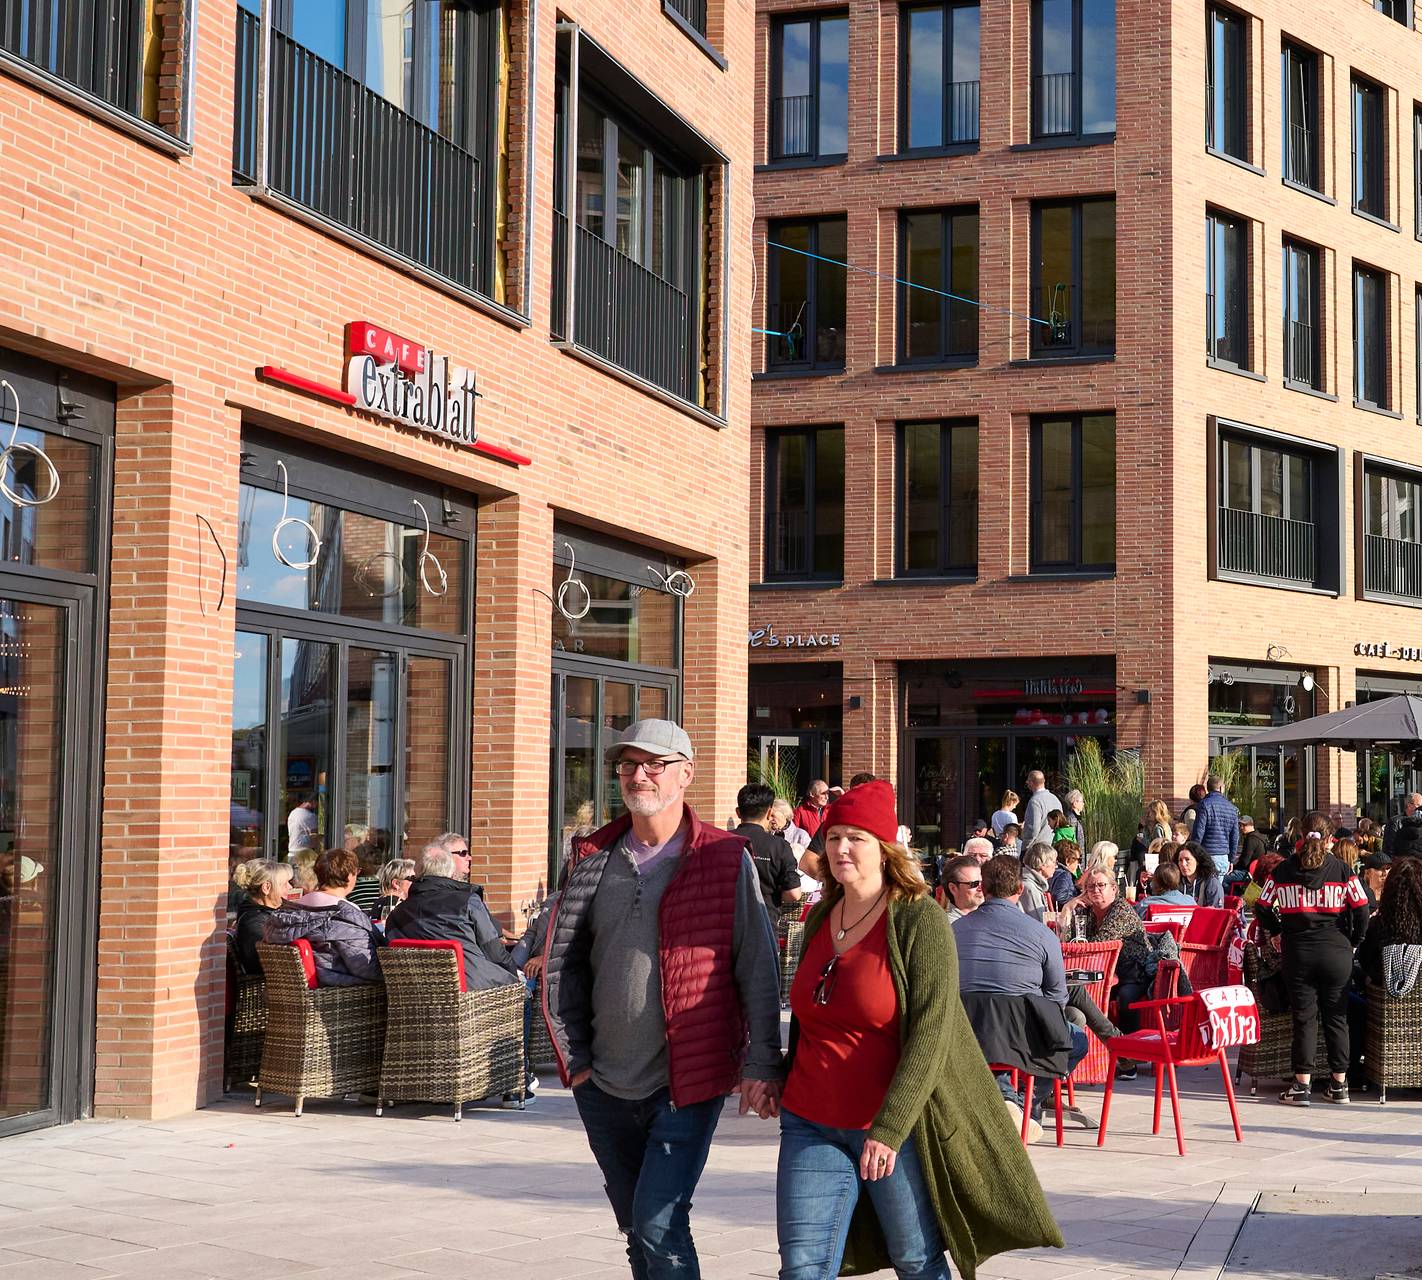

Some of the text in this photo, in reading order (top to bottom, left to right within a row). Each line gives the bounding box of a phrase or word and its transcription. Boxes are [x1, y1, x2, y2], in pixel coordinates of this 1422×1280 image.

[366, 329, 425, 368] CAFE
[362, 349, 483, 443] extrablatt
[748, 623, 840, 647] e's PLACE
[1277, 884, 1348, 909] ONFIDENCE
[1209, 1006, 1257, 1050] extra
